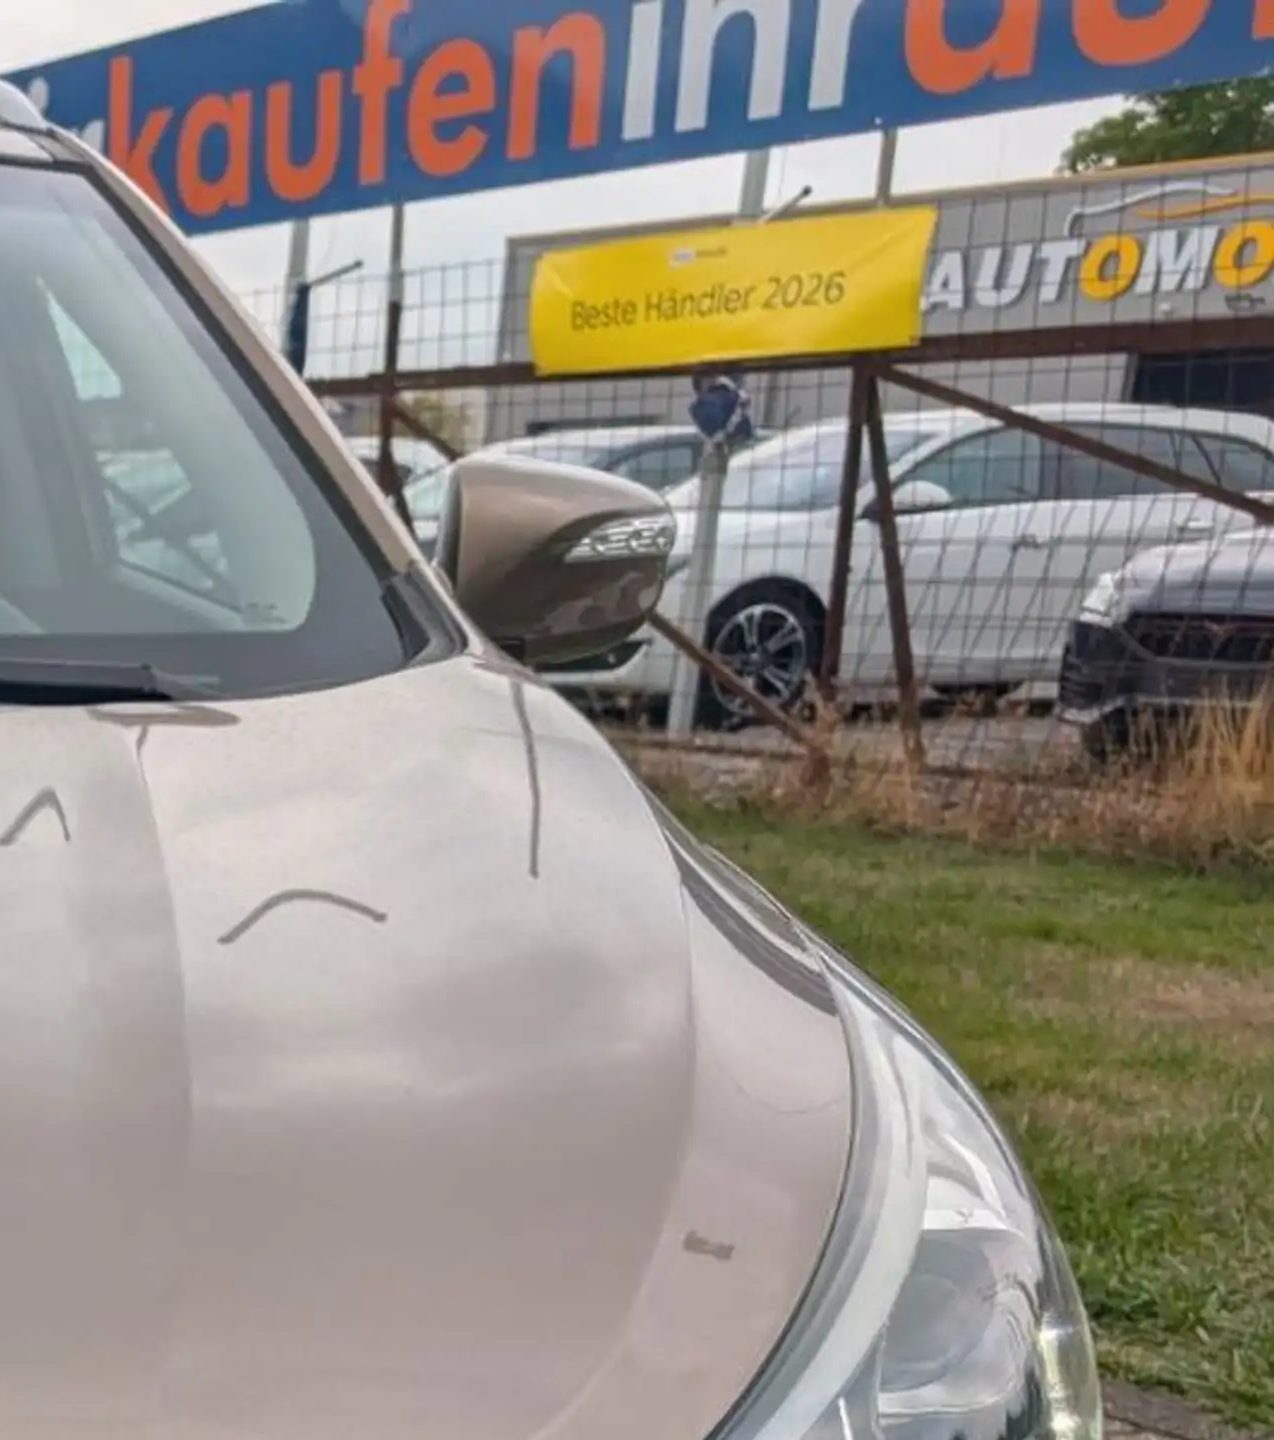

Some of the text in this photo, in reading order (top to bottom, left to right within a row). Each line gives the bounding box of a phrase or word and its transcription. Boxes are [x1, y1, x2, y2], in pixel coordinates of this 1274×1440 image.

[570, 270, 847, 333] Beste Händler 2026
